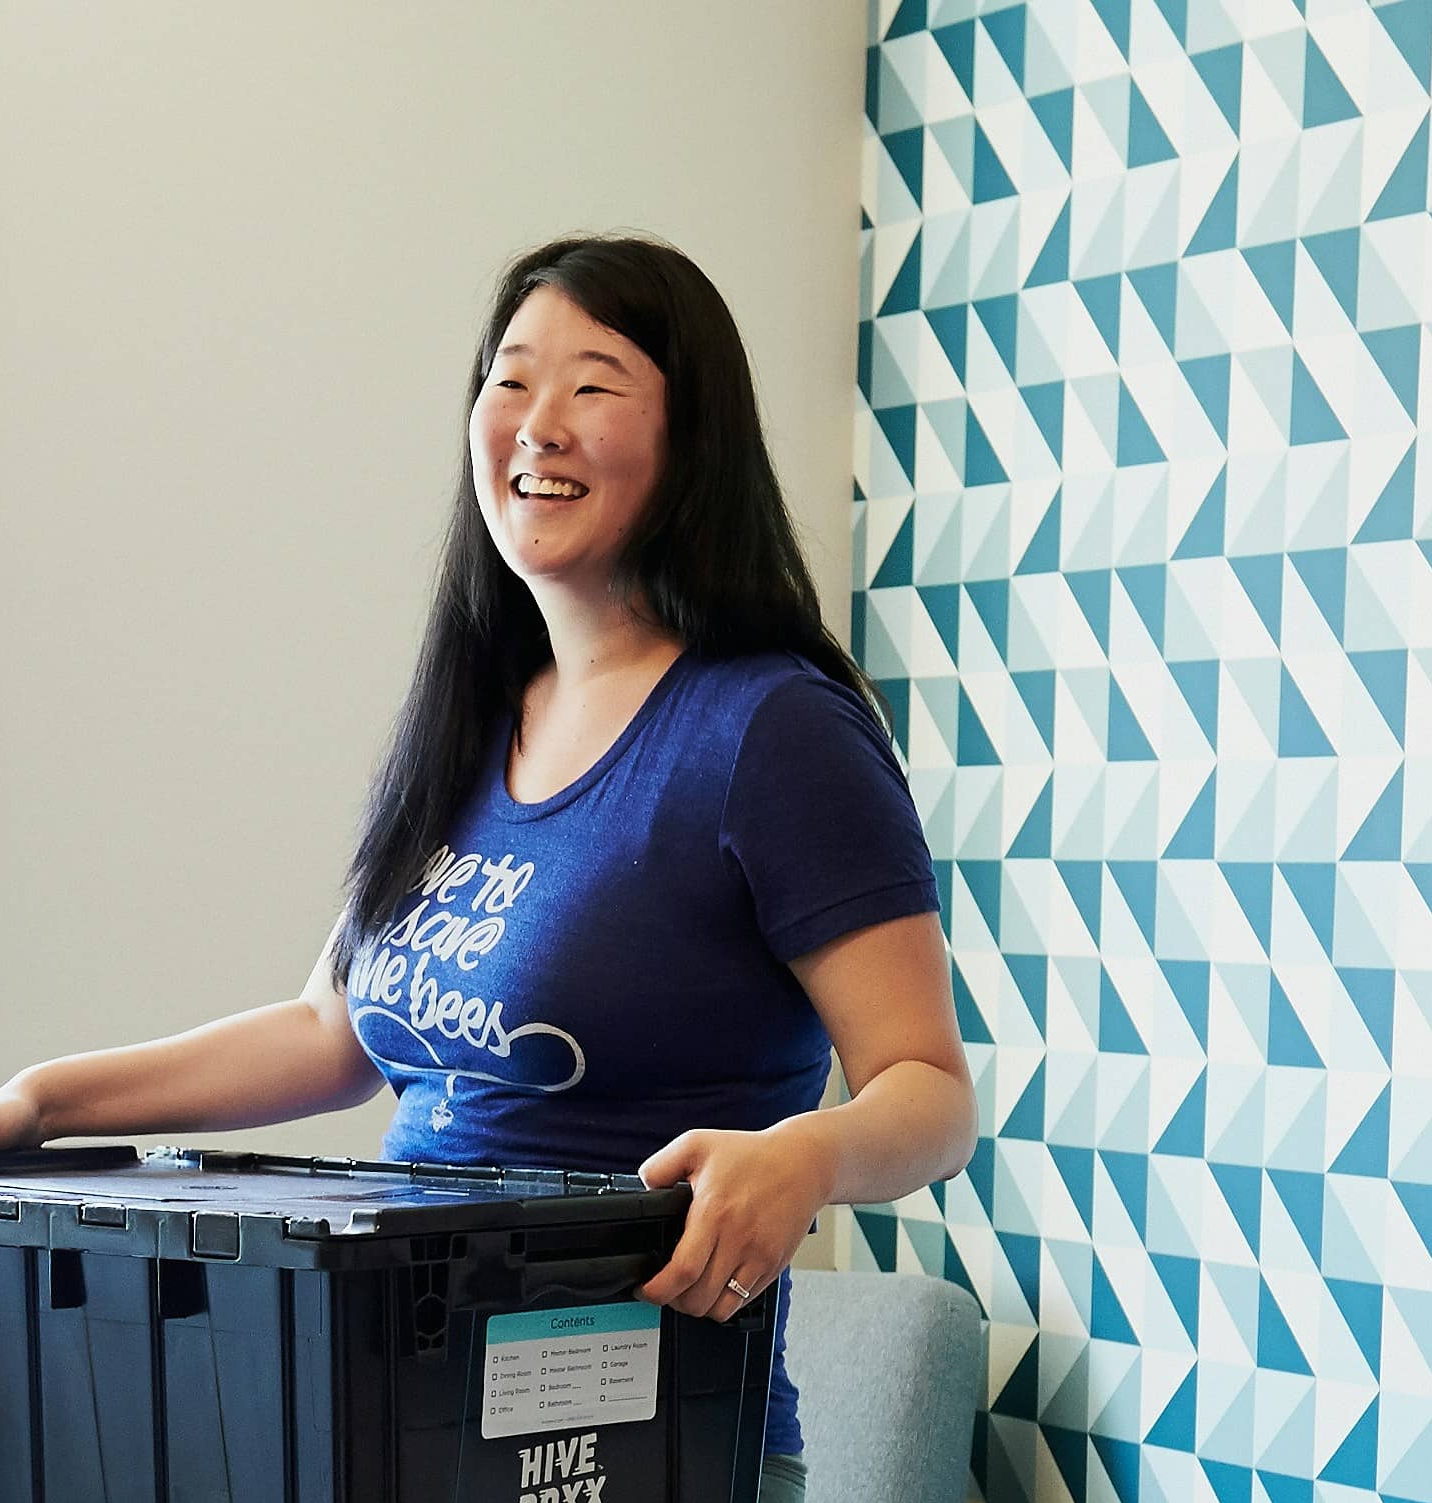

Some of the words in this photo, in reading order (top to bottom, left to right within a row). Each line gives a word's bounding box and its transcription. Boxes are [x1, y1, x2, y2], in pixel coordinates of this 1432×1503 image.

[472, 854, 535, 913] to
[384, 900, 506, 971] save
[410, 953, 511, 1058] bees
[550, 1316, 595, 1329] Contents
[518, 1433, 598, 1488] HIVE
